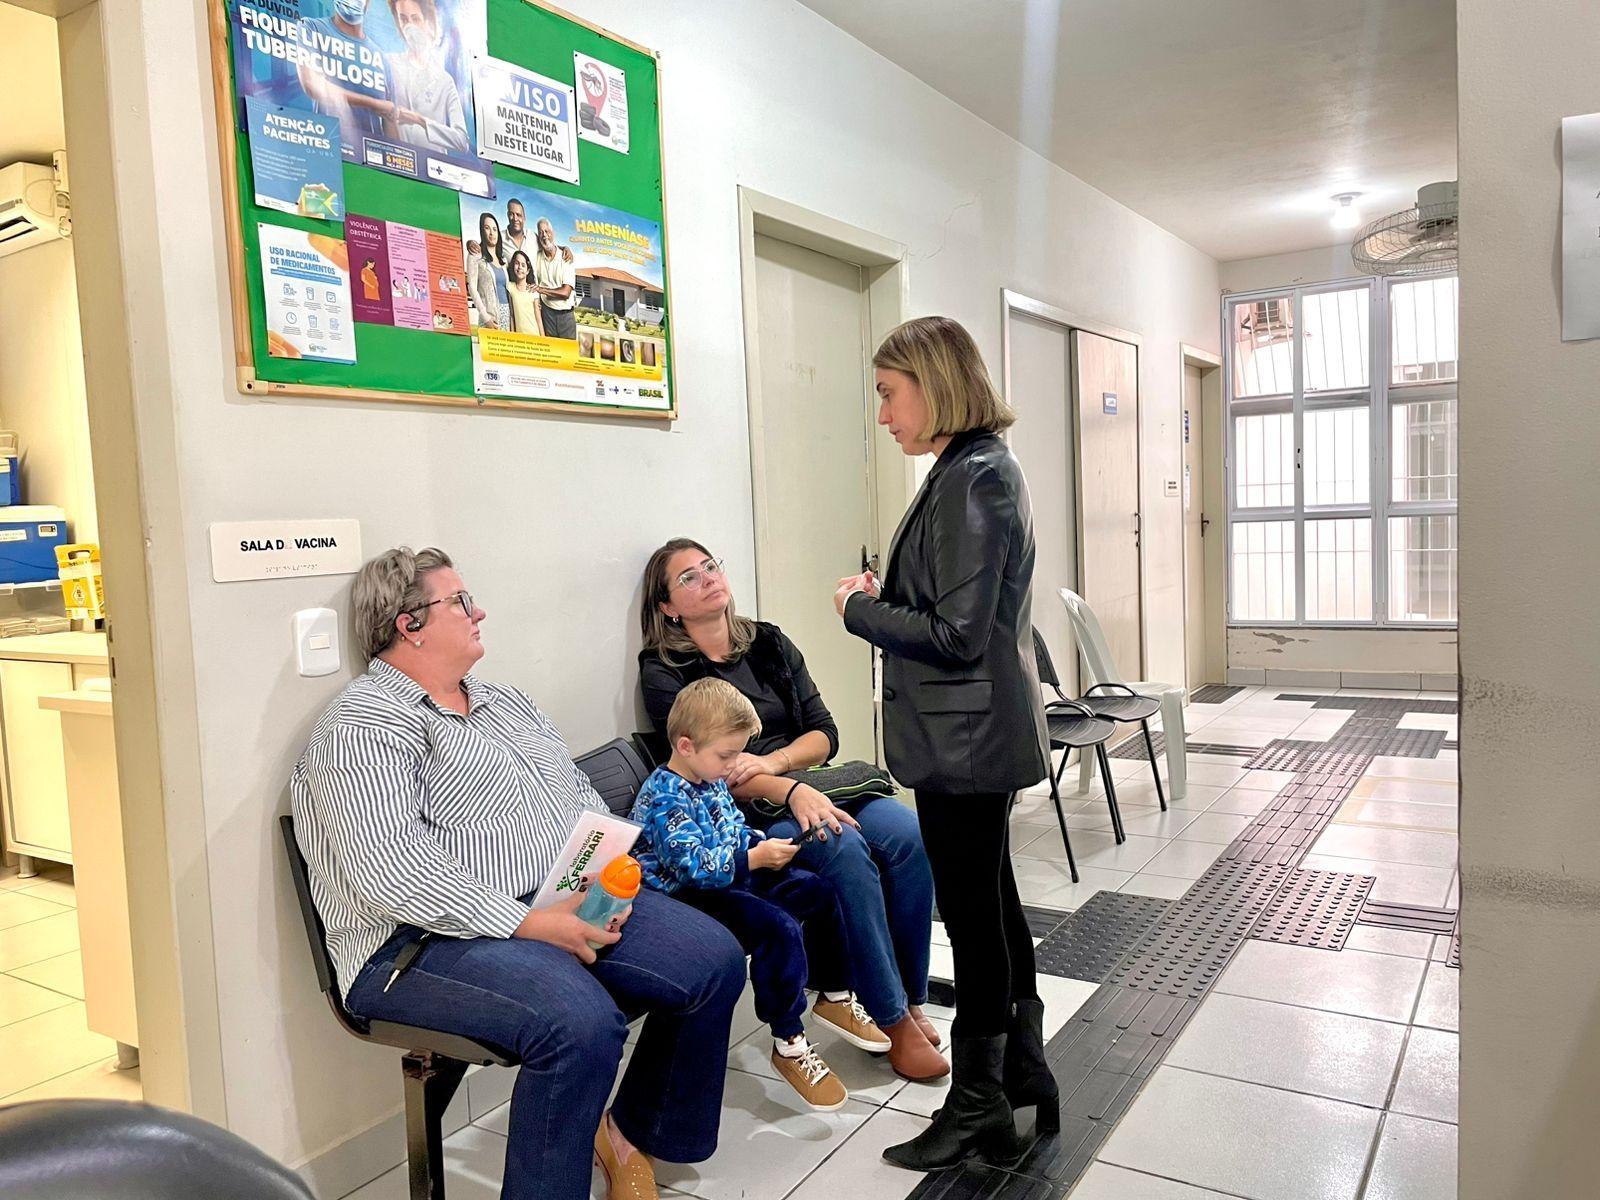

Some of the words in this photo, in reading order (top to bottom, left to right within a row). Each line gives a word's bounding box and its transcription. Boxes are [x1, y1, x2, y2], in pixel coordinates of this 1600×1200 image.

[240, 5, 298, 42] FIQUE
[301, 26, 356, 61] LIVRE
[360, 45, 384, 71] DA
[241, 26, 386, 93] TUBERCULOSE
[504, 76, 561, 118] VISO
[265, 113, 326, 135] ATENÇÃO
[497, 105, 558, 136] MANTENHA
[263, 125, 331, 149] PACIENTES
[505, 122, 553, 147] SILÊNCIO
[494, 133, 528, 153] NESTE
[530, 143, 564, 164] LUGAR
[575, 219, 649, 249] HANSENÍASE
[269, 245, 285, 256] USO
[285, 249, 320, 262] RACIONAL
[270, 256, 280, 265] DE
[280, 258, 335, 275] MEDICAMENTOS
[638, 388, 663, 398] BRASIL
[240, 539, 274, 552] SALA
[294, 537, 338, 549] VACINA
[571, 831, 605, 878] FERRARI
